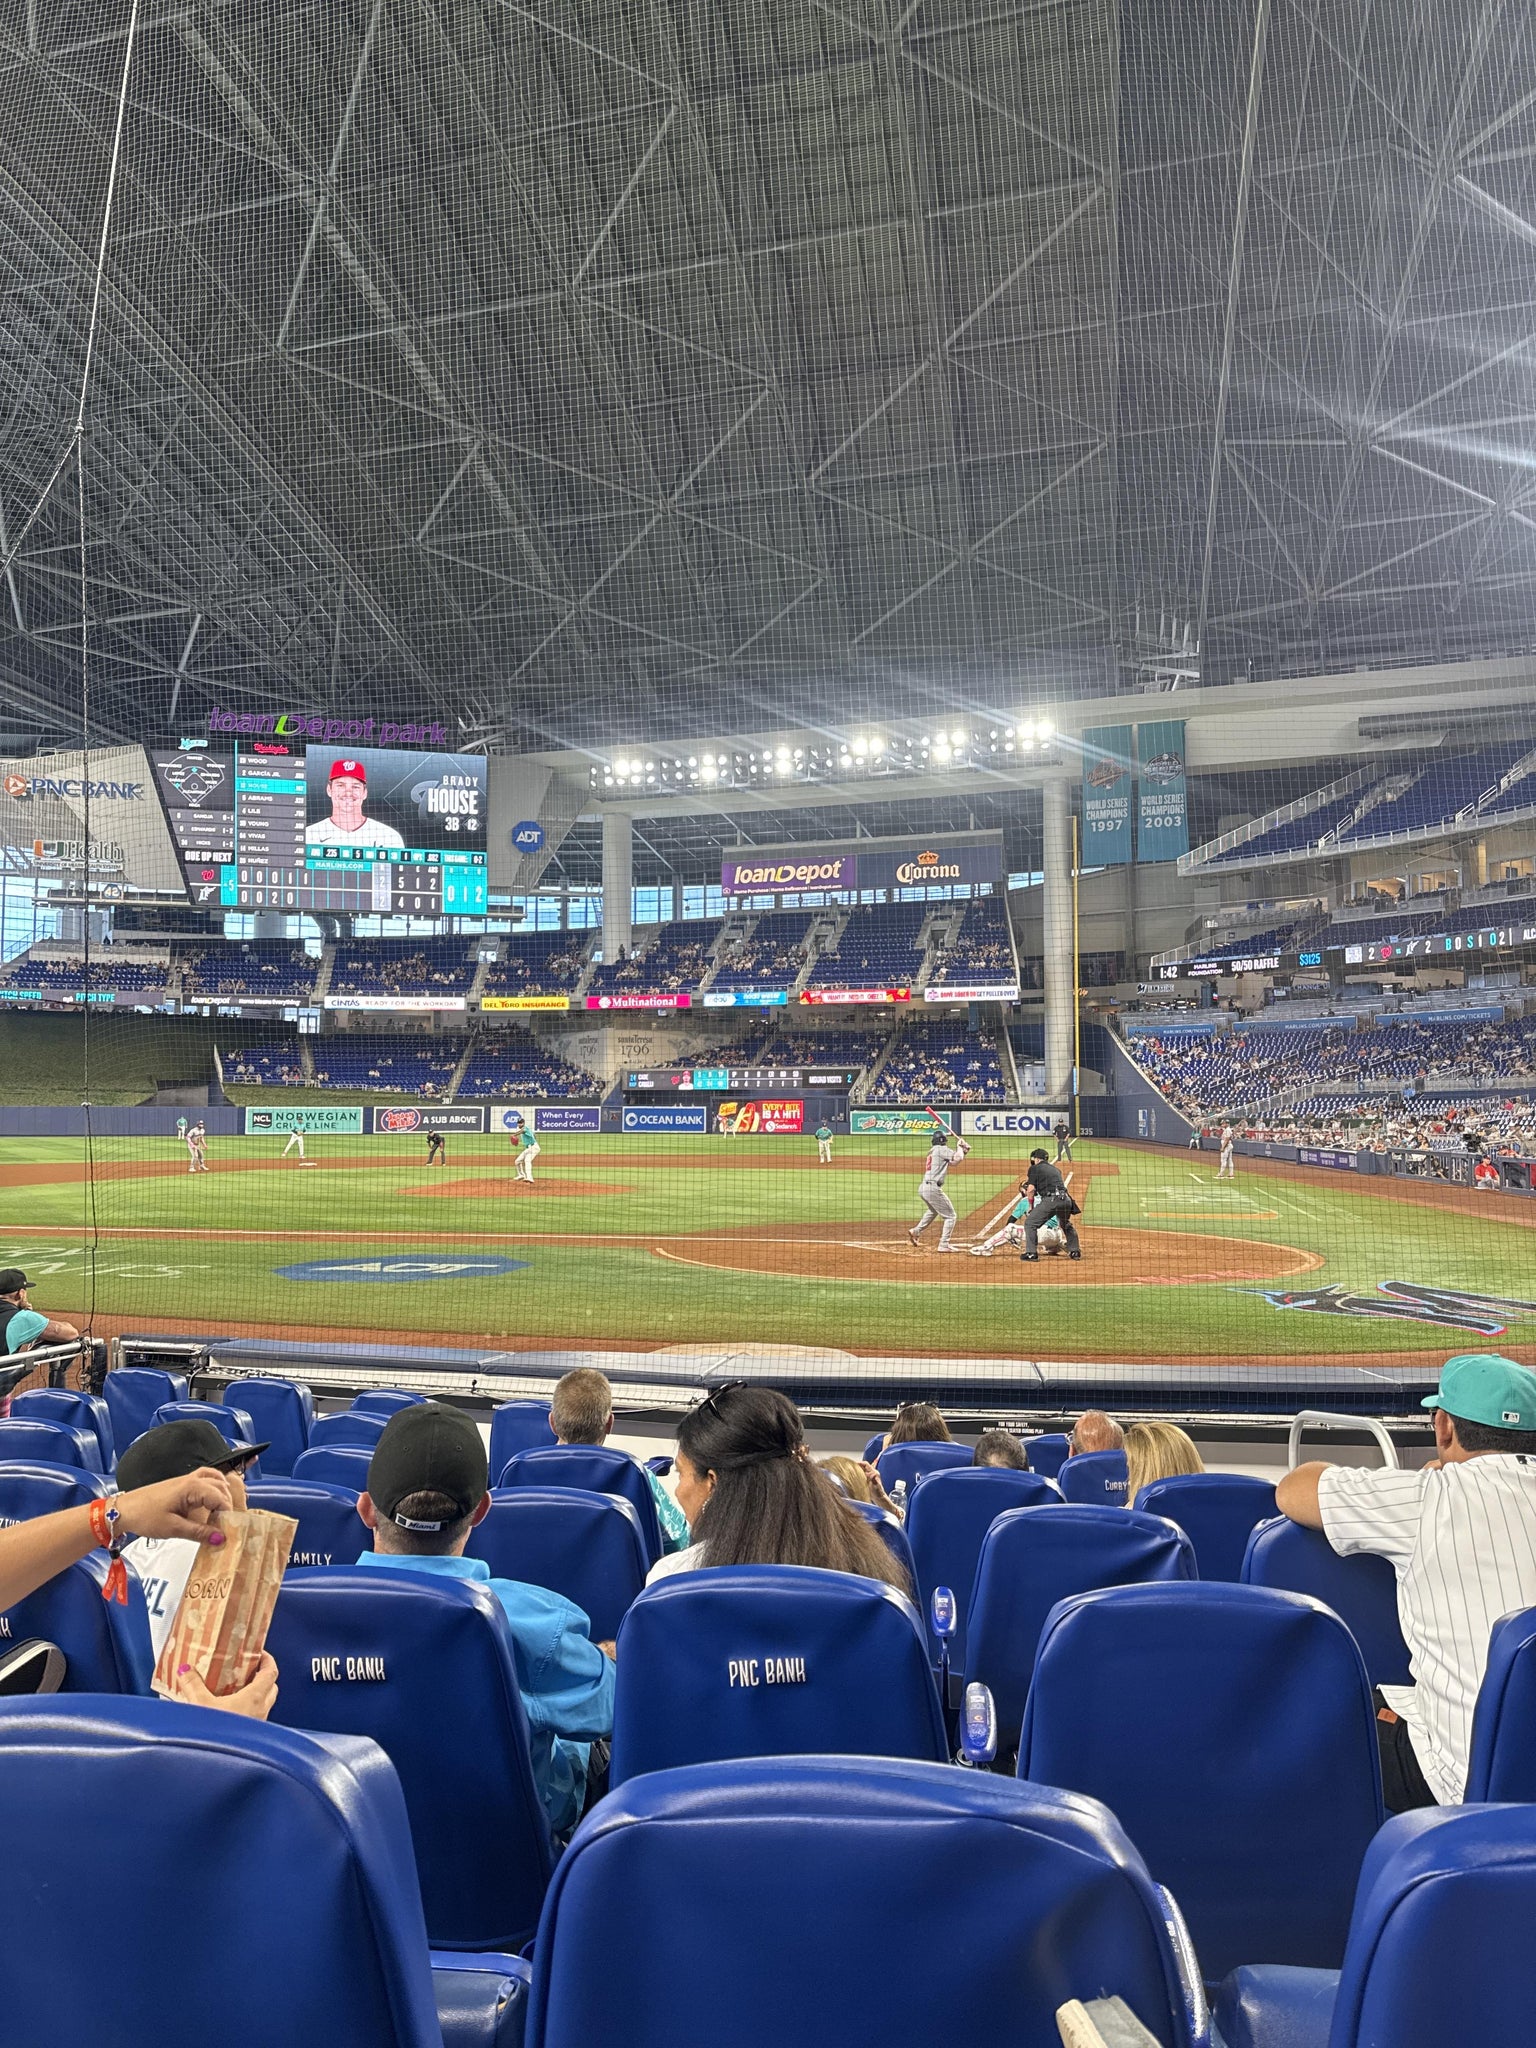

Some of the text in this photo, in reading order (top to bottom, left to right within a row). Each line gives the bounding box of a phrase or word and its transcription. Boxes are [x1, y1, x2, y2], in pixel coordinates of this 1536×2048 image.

[208, 707, 448, 746] loanDepot park
[443, 775, 479, 787] BRADY
[428, 788, 479, 815] HOUSE
[1086, 797, 1128, 810] WORLD SERIES
[1141, 793, 1184, 806] WORLD SERIES
[1086, 808, 1128, 820] CHAMPIONS
[1141, 804, 1184, 816] CHAMPIONS
[445, 817, 478, 831] 3B 12
[1091, 820, 1122, 832] 1997
[1145, 816, 1182, 828] 2003
[515, 829, 541, 844] ADT
[185, 851, 232, 863] DUE UP NEXT
[734, 859, 841, 885] loanDepot
[896, 862, 961, 885] Corona
[241, 870, 247, 882] 0
[257, 871, 262, 883] 0
[272, 872, 278, 884] 0
[379, 877, 385, 888] 2
[399, 877, 404, 888] 5
[430, 878, 435, 890] 2
[104, 887, 119, 897] 42
[476, 886, 482, 902] 2
[241, 892, 247, 903] 0
[257, 893, 262, 903] 0
[272, 892, 277, 904] 2
[287, 893, 293, 904] 0
[379, 896, 385, 907] 2
[398, 897, 404, 908] 4
[415, 897, 420, 909] 0
[1369, 948, 1375, 960] 2
[1425, 941, 1431, 953] 2
[1445, 938, 1452, 950] B
[1467, 936, 1473, 948] S
[1499, 932, 1506, 945] 2
[1231, 957, 1279, 971] 50/50 RAFFLE
[1160, 966, 1178, 979] 1:42
[1188, 968, 1223, 977] FOUNDATION
[76, 993, 116, 1003] PITCH TYPE
[191, 996, 231, 1005] loanDepot
[331, 997, 360, 1007] CINTAS
[612, 996, 677, 1008] Multinational
[1429, 1012, 1491, 1021] MARLINS.COM/TICKETS
[621, 1045, 650, 1058] 1796
[847, 1075, 852, 1083] 2
[253, 1115, 271, 1123] NCL
[275, 1112, 357, 1121] NORWEGIAN
[423, 1116, 477, 1124] A SUB ABOVE
[564, 1112, 584, 1120] Every
[639, 1115, 703, 1125] OCEAN BANK
[762, 1110, 800, 1119] IS A HIT!
[569, 1120, 598, 1128] Counts.
[876, 1120, 904, 1129] Baja
[904, 1118, 940, 1129] Blast
[993, 1116, 1051, 1131] LEON
[1080, 1128, 1093, 1136] 335
[310, 1262, 502, 1274] ADT
[408, 1522, 436, 1530] Miami
[311, 1655, 386, 1682] PNC BANK
[728, 1656, 806, 1688] PNC BANK
